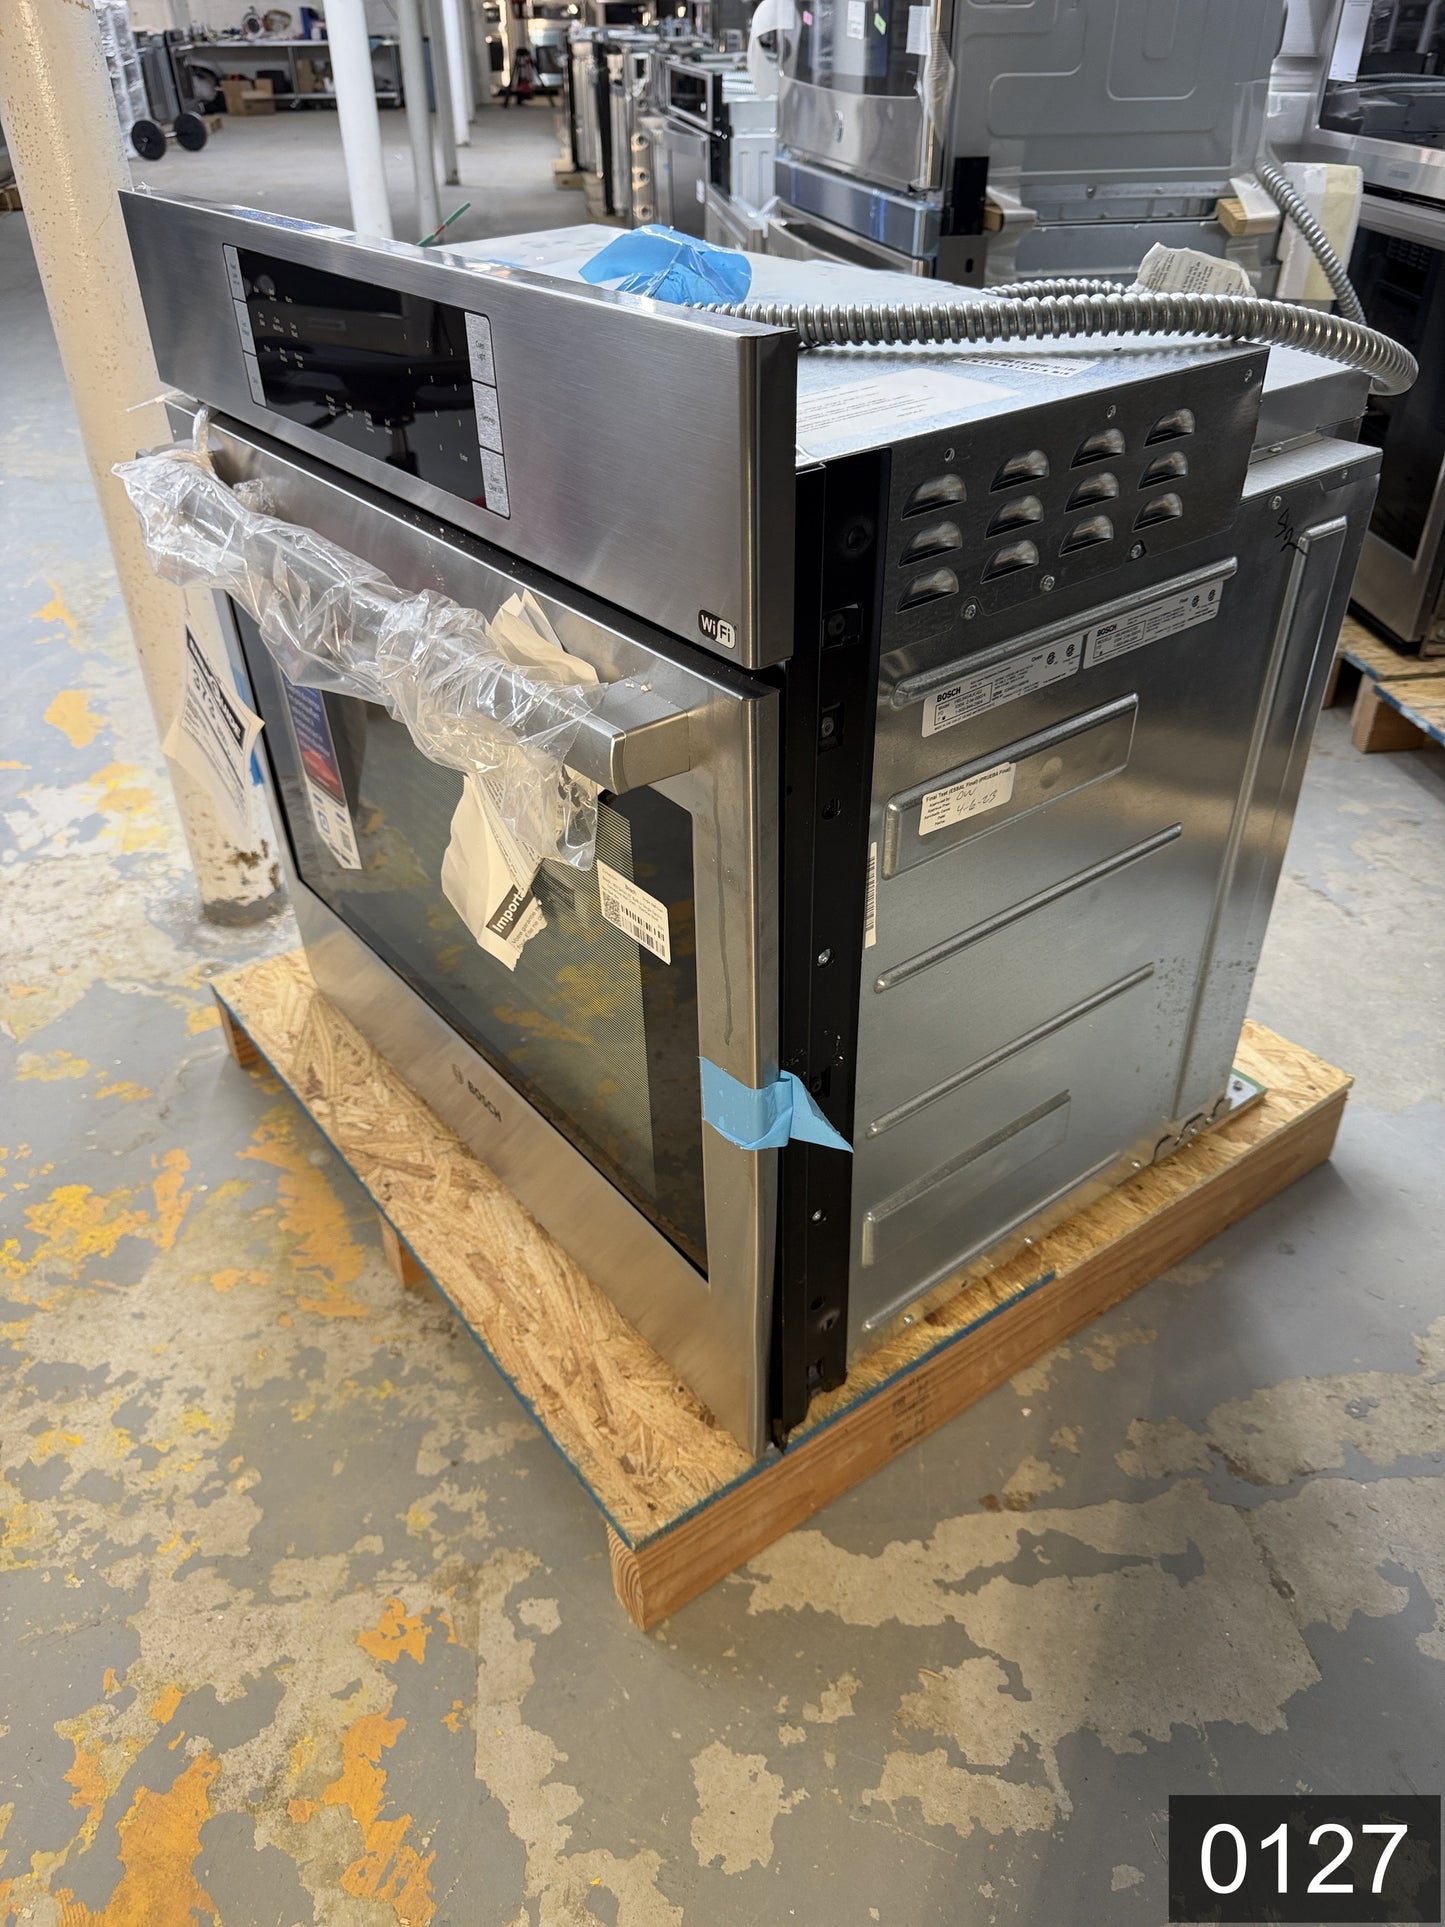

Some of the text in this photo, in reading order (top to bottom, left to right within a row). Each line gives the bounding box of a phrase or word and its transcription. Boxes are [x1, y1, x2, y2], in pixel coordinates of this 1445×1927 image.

[700, 614, 731, 643] WiFi
[936, 686, 962, 703] BOSCH
[467, 1079, 503, 1123] BOSCH
